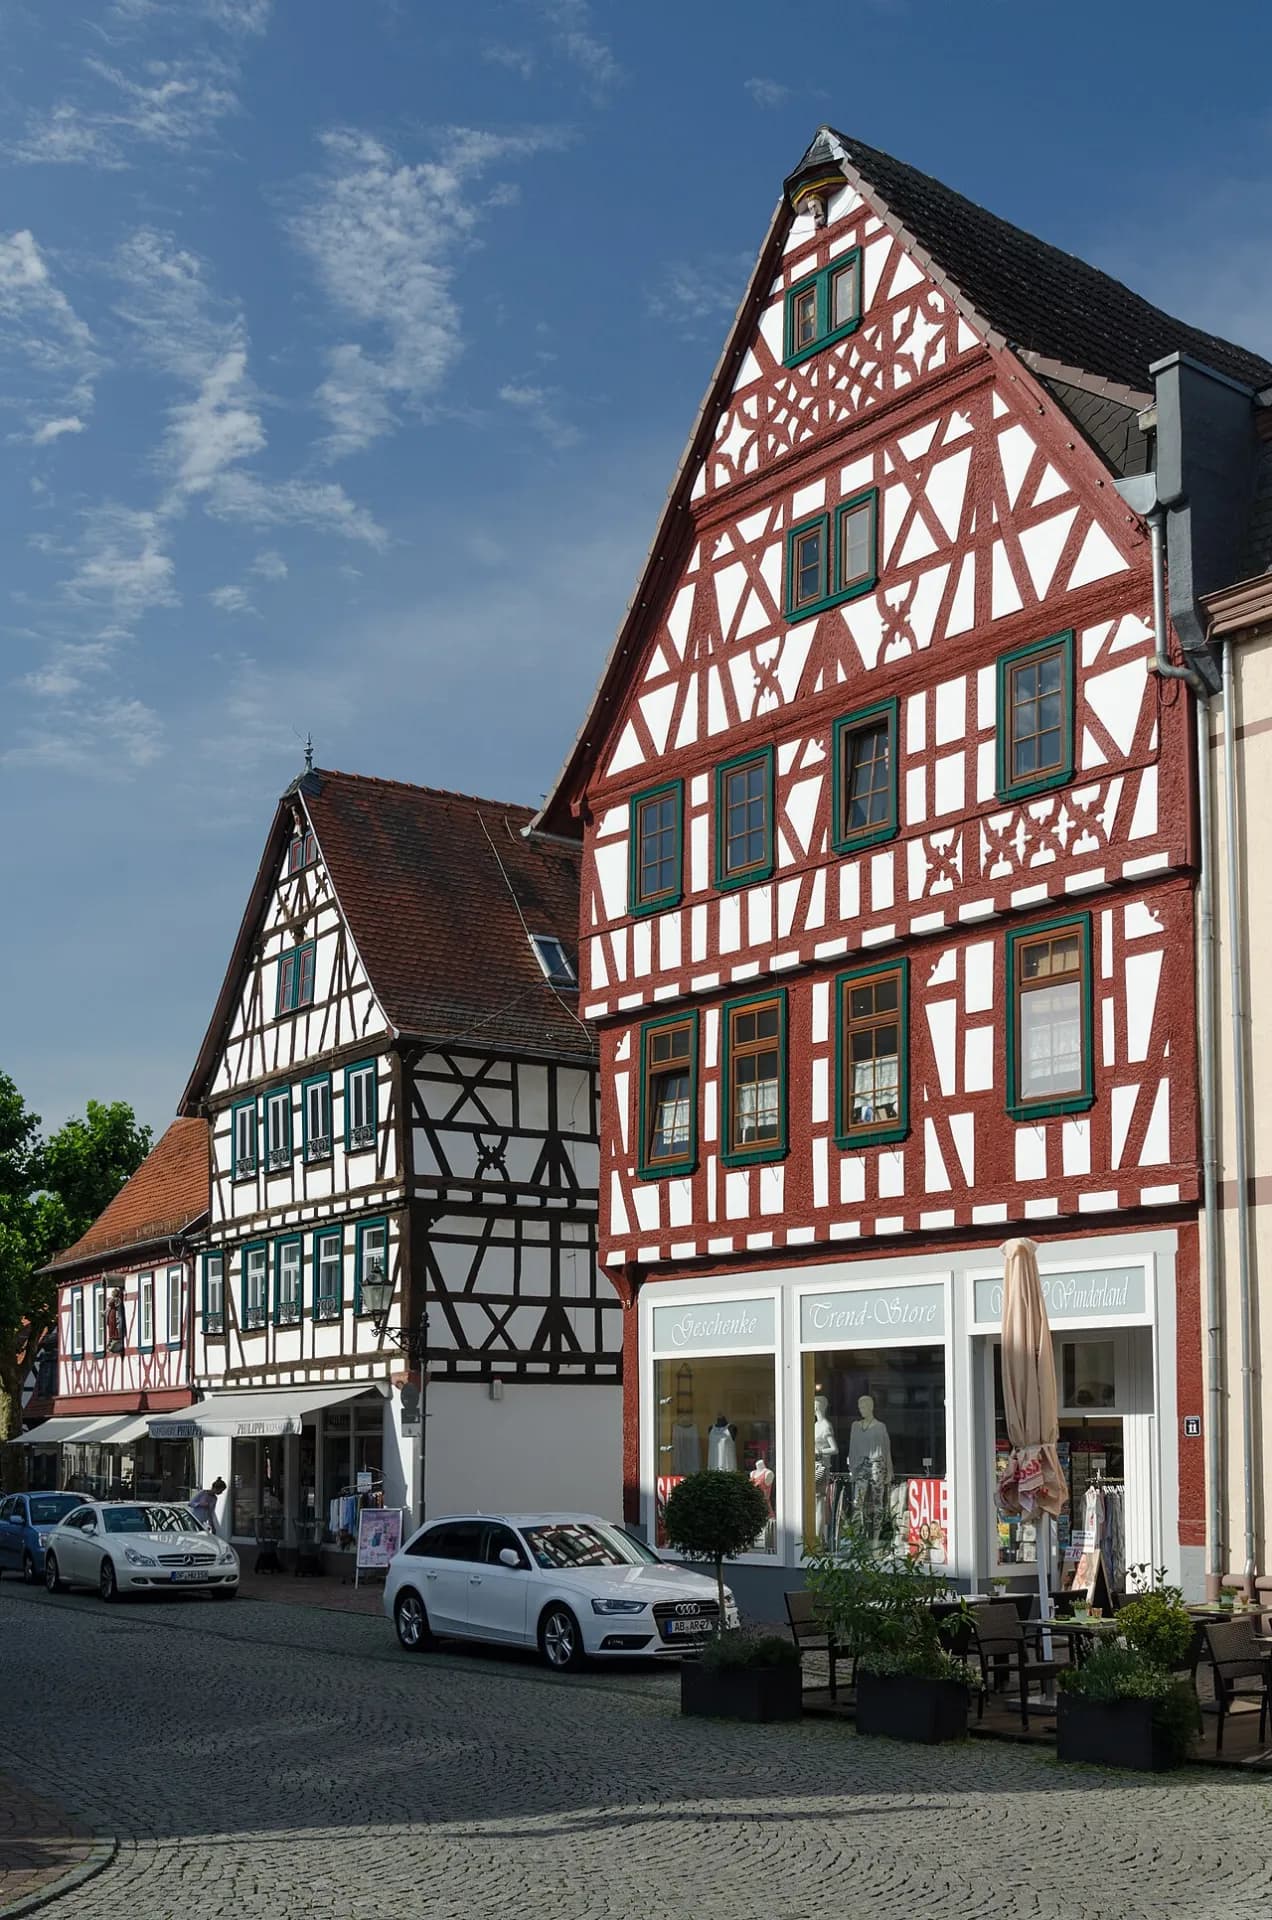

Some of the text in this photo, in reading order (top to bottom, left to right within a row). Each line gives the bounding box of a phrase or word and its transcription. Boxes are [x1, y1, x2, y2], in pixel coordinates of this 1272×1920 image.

[1051, 1276, 1129, 1311] Wunderland
[671, 1310, 758, 1346] Geschenke
[809, 1297, 937, 1329] Trend-Store
[1188, 1423, 1198, 1434] 11
[908, 1480, 948, 1529] SALE
